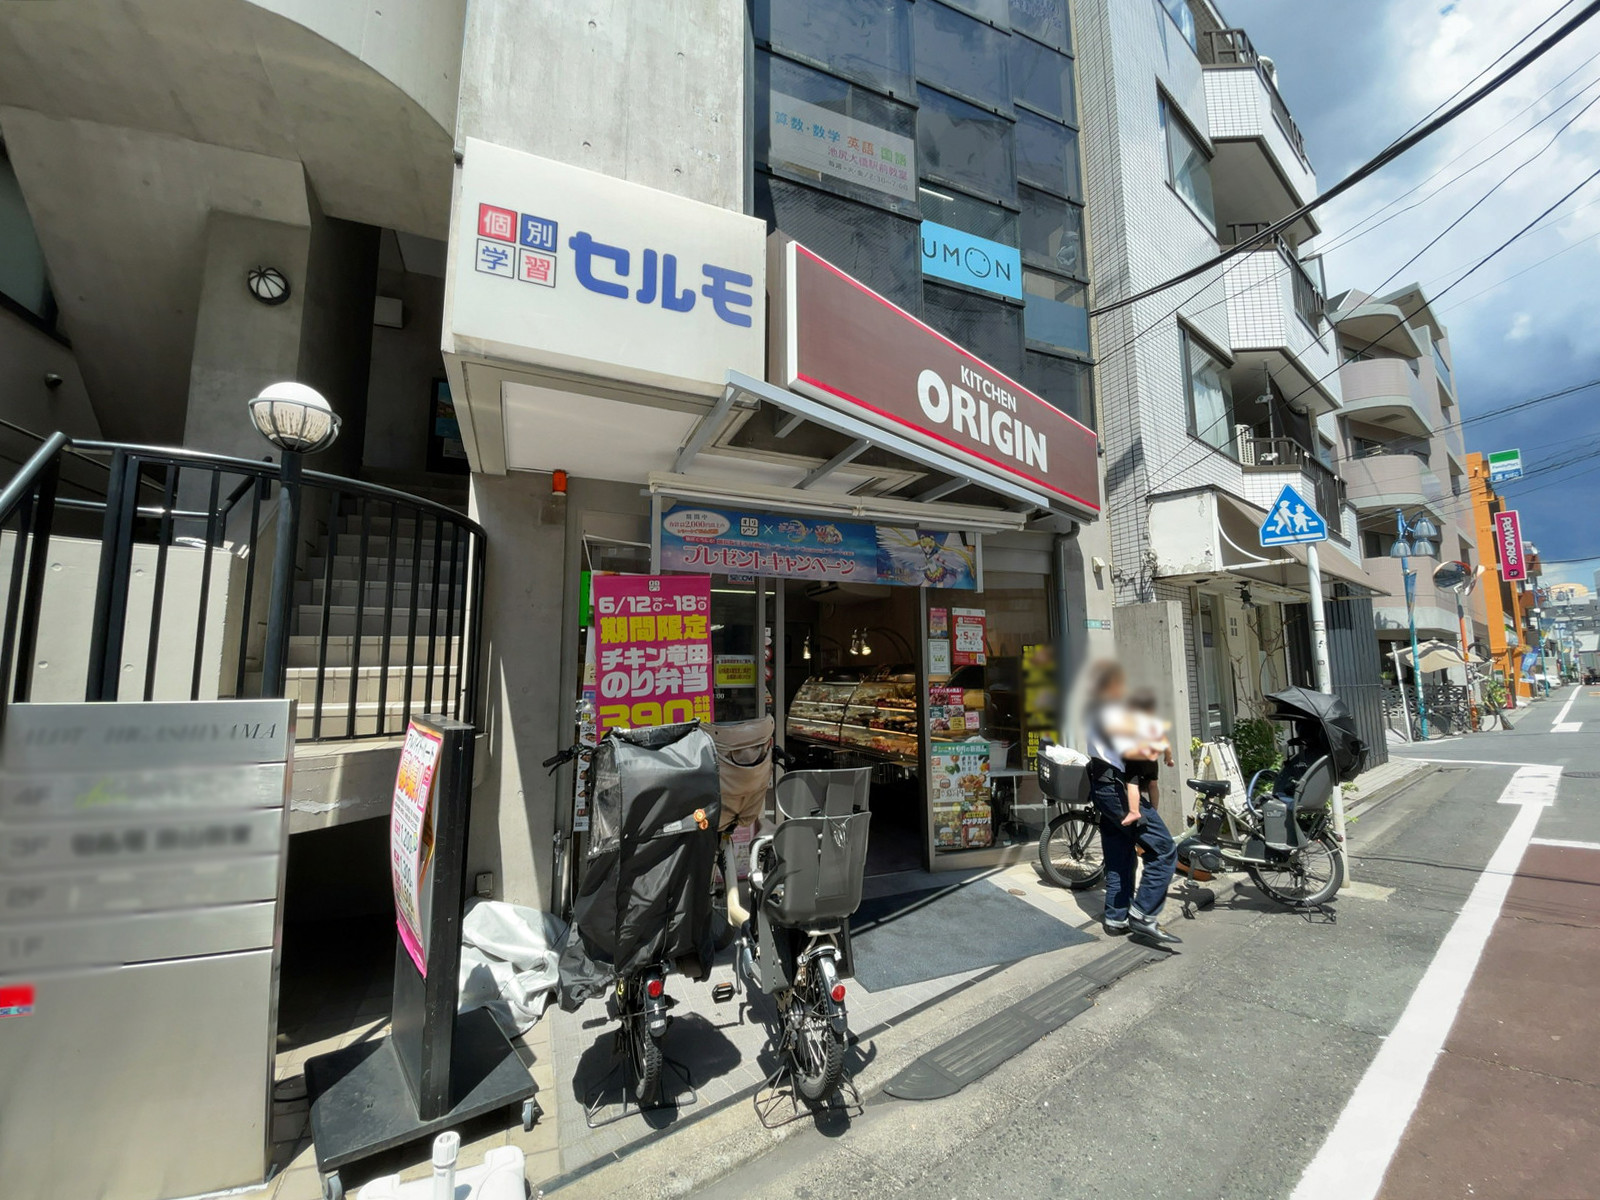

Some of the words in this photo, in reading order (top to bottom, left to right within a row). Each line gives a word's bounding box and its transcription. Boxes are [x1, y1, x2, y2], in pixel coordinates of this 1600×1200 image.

[847, 136, 875, 156] 英語
[483, 209, 553, 248] 個別
[480, 244, 551, 283] 学習
[568, 231, 753, 328] セルモ
[960, 365, 1017, 413] KITCHEN
[917, 368, 1048, 473] ORIGIN
[683, 544, 854, 575] プレゼントキャンペーン
[600, 614, 708, 644] 期間限定
[601, 644, 708, 672] チキン竜田
[600, 665, 708, 698] のり弁当
